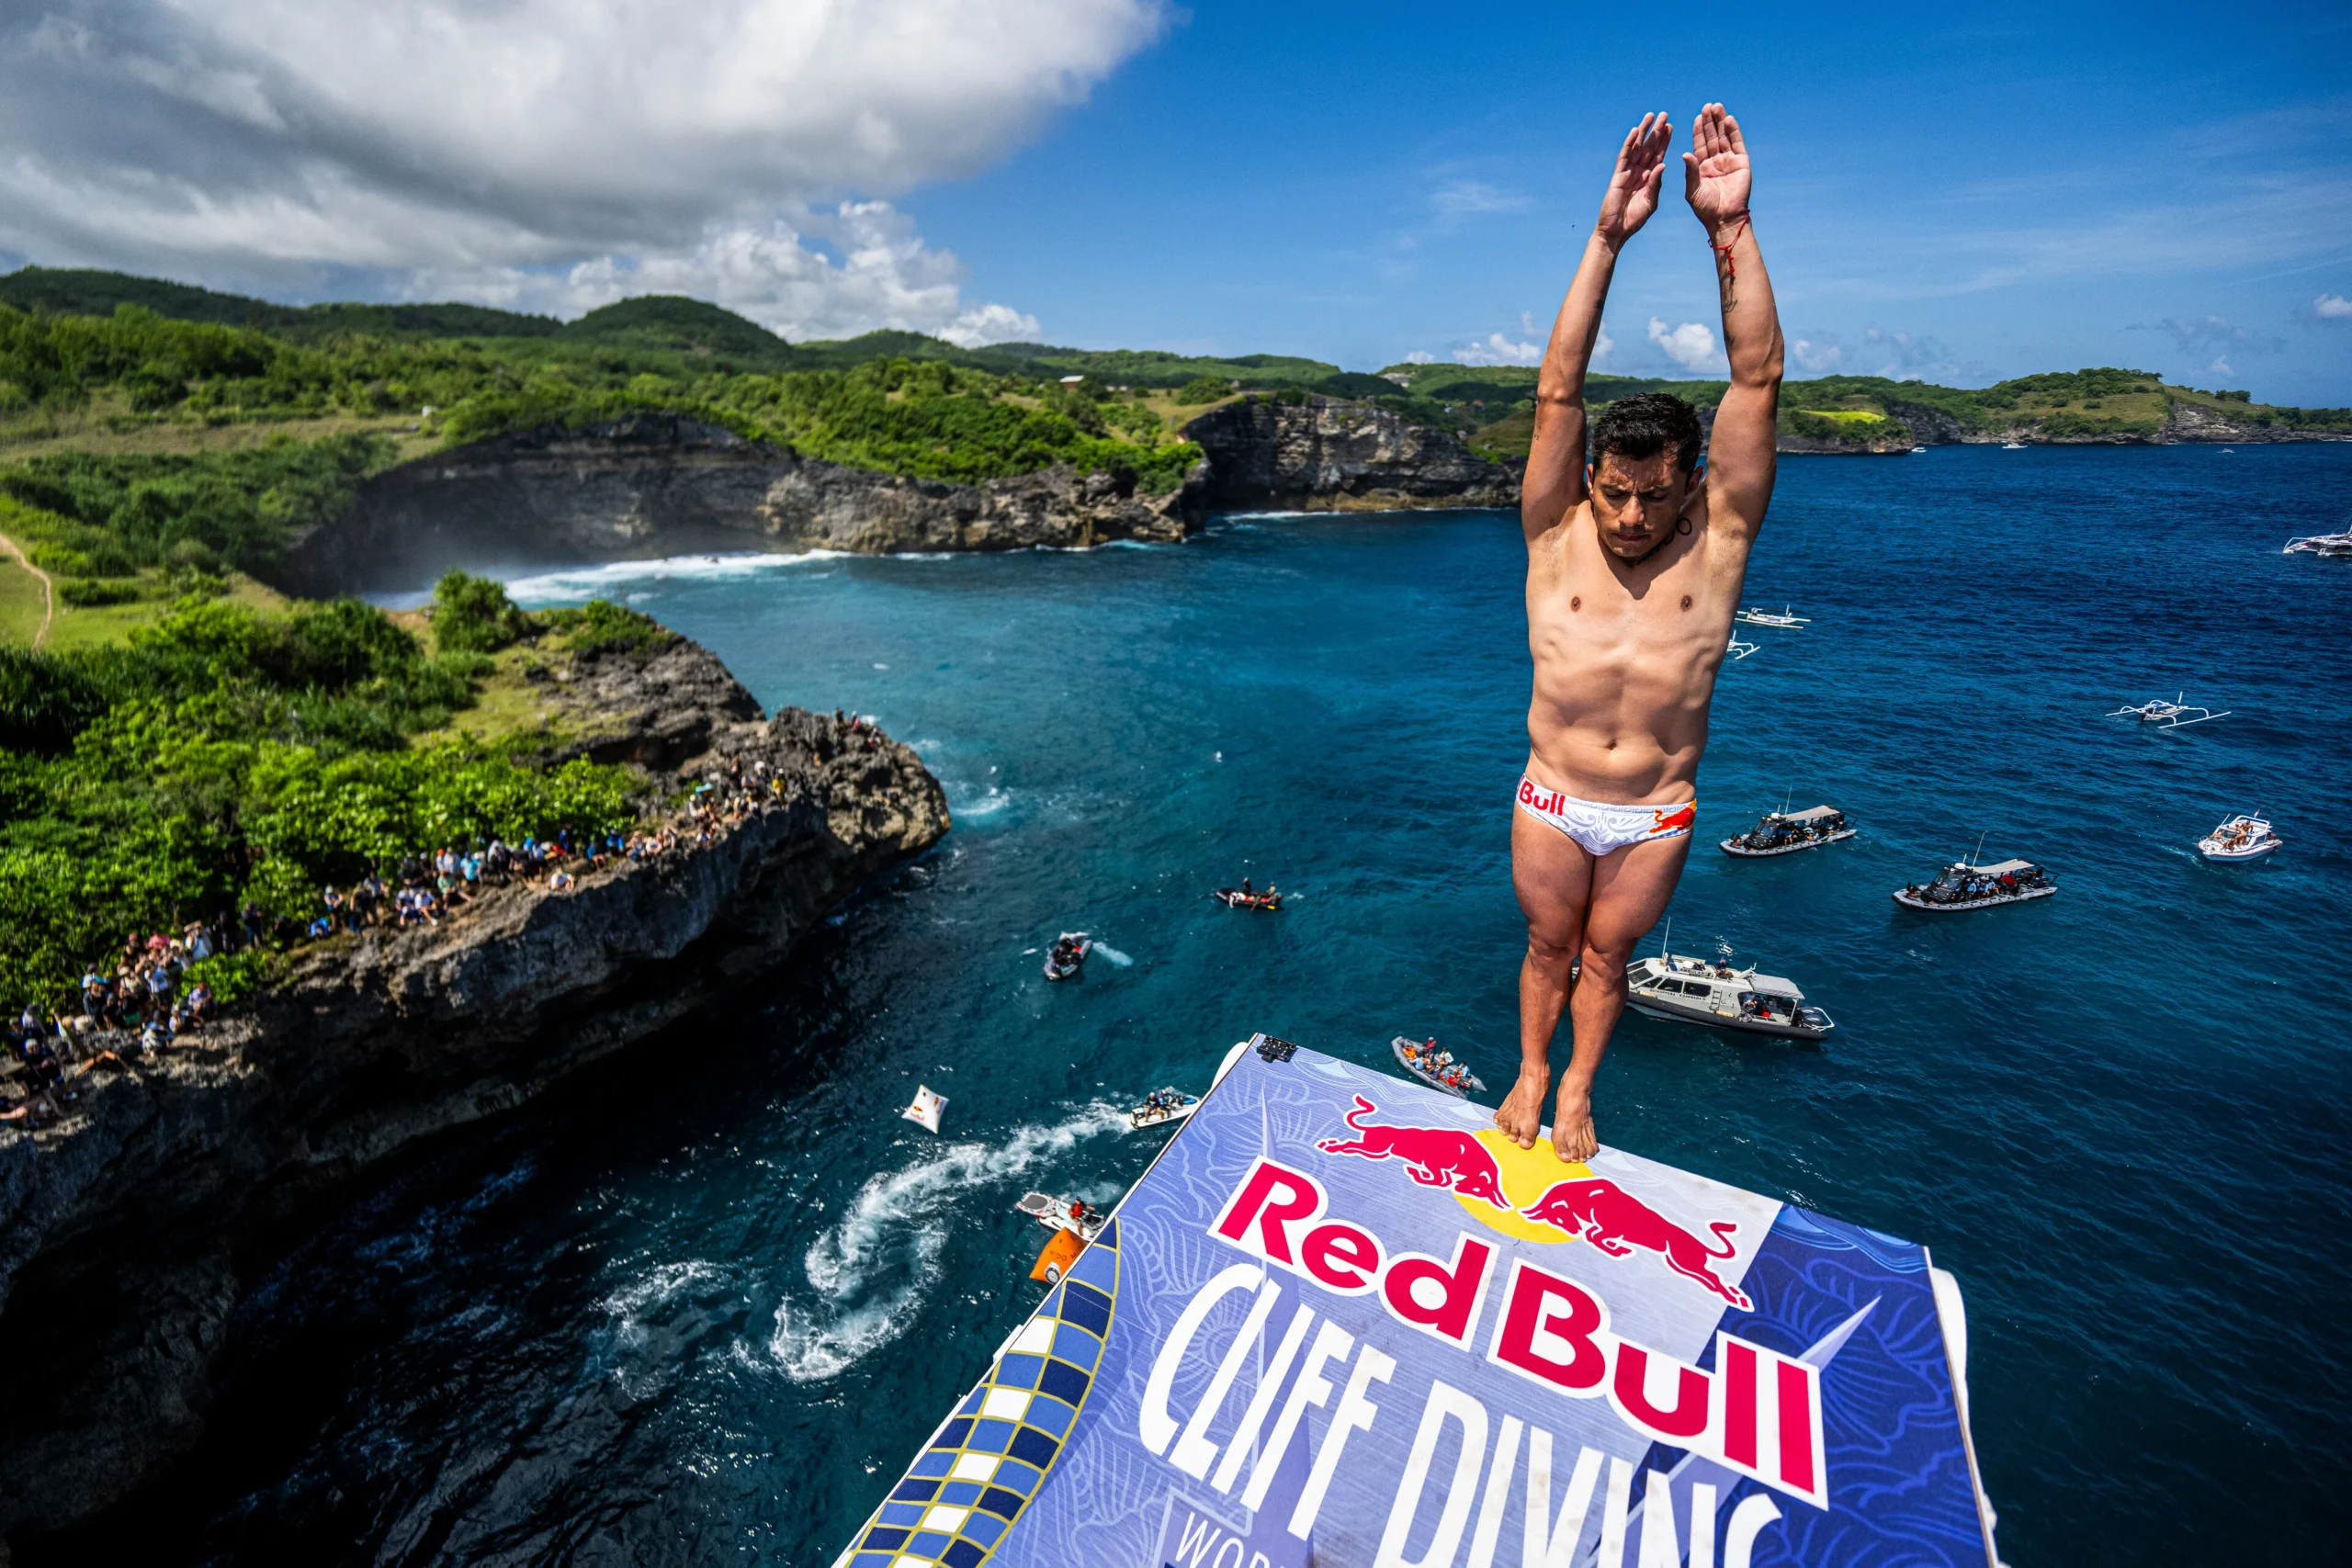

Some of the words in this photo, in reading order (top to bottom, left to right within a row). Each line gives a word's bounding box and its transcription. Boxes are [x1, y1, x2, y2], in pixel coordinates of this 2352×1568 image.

[1519, 780, 1566, 817] Bull
[1139, 1263, 1397, 1541] CLIFF
[1216, 1159, 1492, 1343] Red
[1495, 1263, 1816, 1496] Bull
